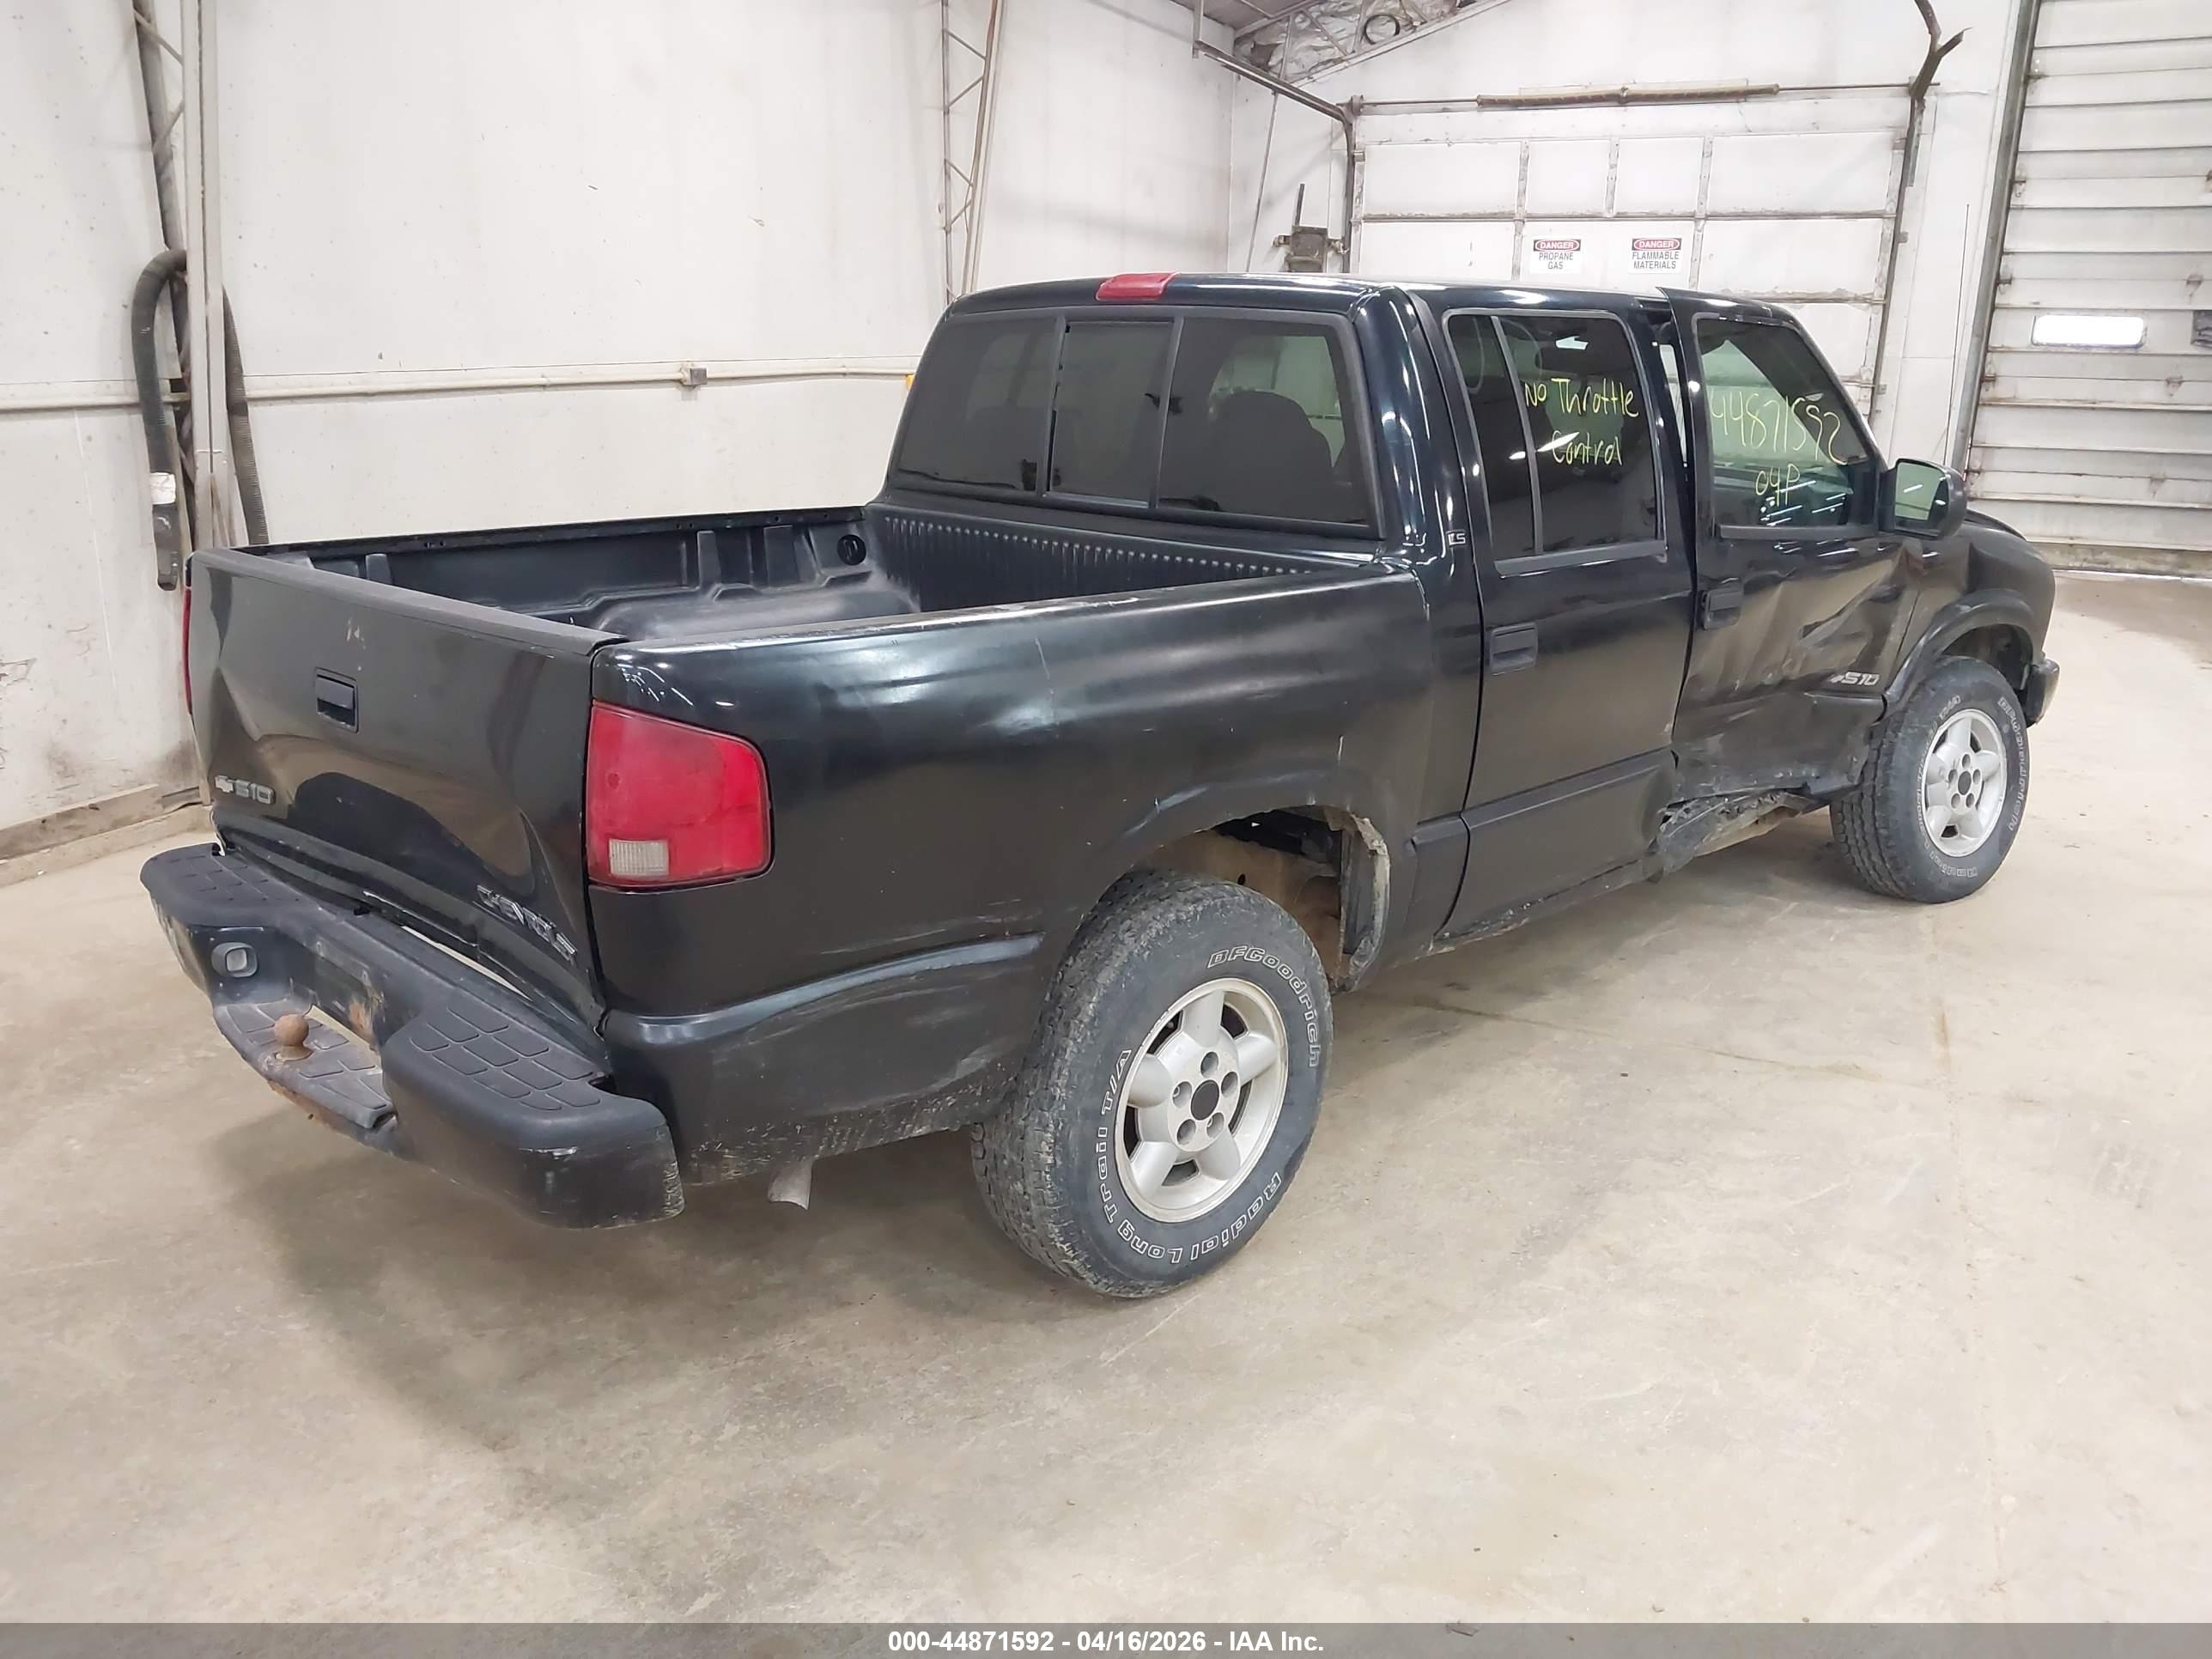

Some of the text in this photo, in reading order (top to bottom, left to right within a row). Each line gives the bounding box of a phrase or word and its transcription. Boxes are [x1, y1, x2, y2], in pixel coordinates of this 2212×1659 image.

[1540, 240, 1575, 250] DANGER
[1638, 240, 1674, 249] DANGER
[1539, 252, 1574, 261] PROPANE
[1632, 251, 1680, 260] FLAMMABLE
[1547, 261, 1564, 270] GAS
[1633, 260, 1676, 270] MATERIALS
[1551, 377, 1639, 417] Throttle
[1709, 388, 1848, 465] 44871592
[1552, 429, 1623, 466] Control
[1840, 671, 1881, 686] S10
[1206, 945, 1322, 1067] BFGoodrich
[1095, 1048, 1282, 1264] Radial Long Trail T/A
